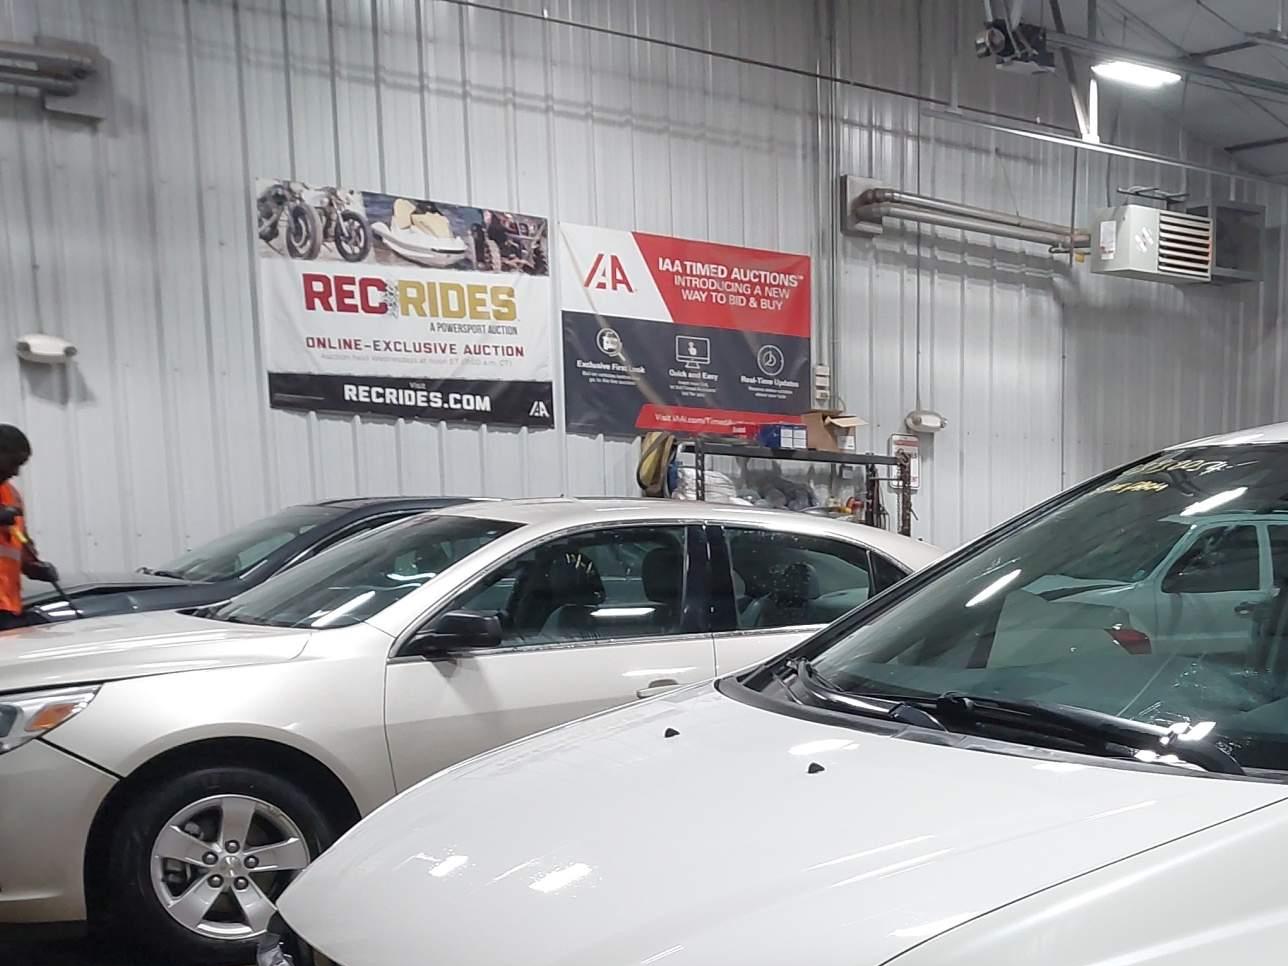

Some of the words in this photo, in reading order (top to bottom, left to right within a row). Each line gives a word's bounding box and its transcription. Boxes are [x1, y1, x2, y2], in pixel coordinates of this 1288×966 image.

[658, 256, 682, 273] IAA
[684, 260, 727, 279] TIMED
[302, 273, 388, 315] REC
[398, 280, 518, 321] RIDES
[674, 275, 751, 294] INTRODUCING
[754, 284, 762, 296] A
[764, 285, 790, 299] NEW
[681, 288, 707, 303] WAY
[710, 291, 726, 304] TO
[729, 294, 746, 307] BID
[749, 296, 758, 309] &
[760, 298, 784, 311] BUY
[429, 322, 436, 332] A
[437, 322, 486, 334] POWERSPORT
[487, 325, 518, 335] AUCTION
[306, 336, 458, 354] ONLINE-EXCLUSIVE
[463, 344, 525, 357] AUCTION
[343, 384, 492, 412] RECRIDES.COM
